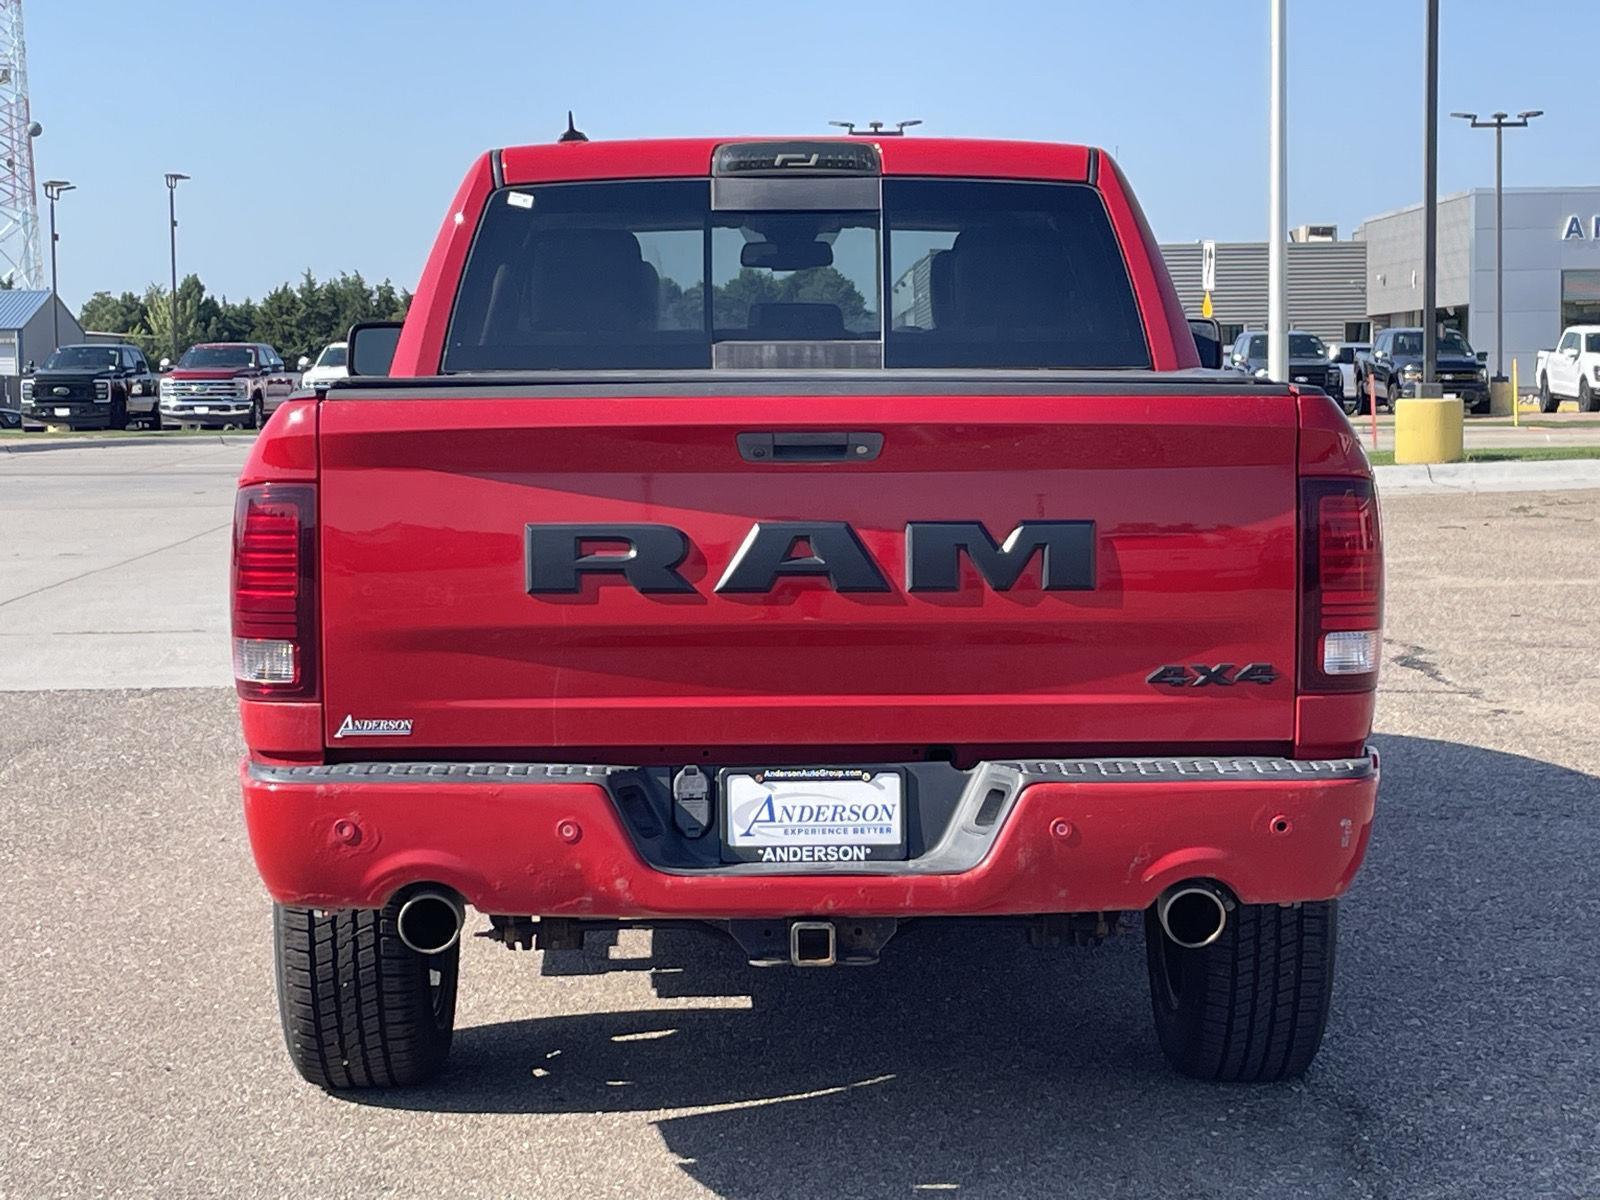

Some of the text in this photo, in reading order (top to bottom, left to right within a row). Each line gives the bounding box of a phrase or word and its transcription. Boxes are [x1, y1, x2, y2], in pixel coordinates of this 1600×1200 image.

[525, 520, 1096, 593] RAM
[334, 714, 413, 738] ANDERSON
[764, 769, 862, 778] AndersonAutoGroup.com
[740, 794, 896, 837] ANDERSON
[783, 826, 892, 836] EXPERIENCE BETTER
[761, 845, 866, 862] ANDERSON
